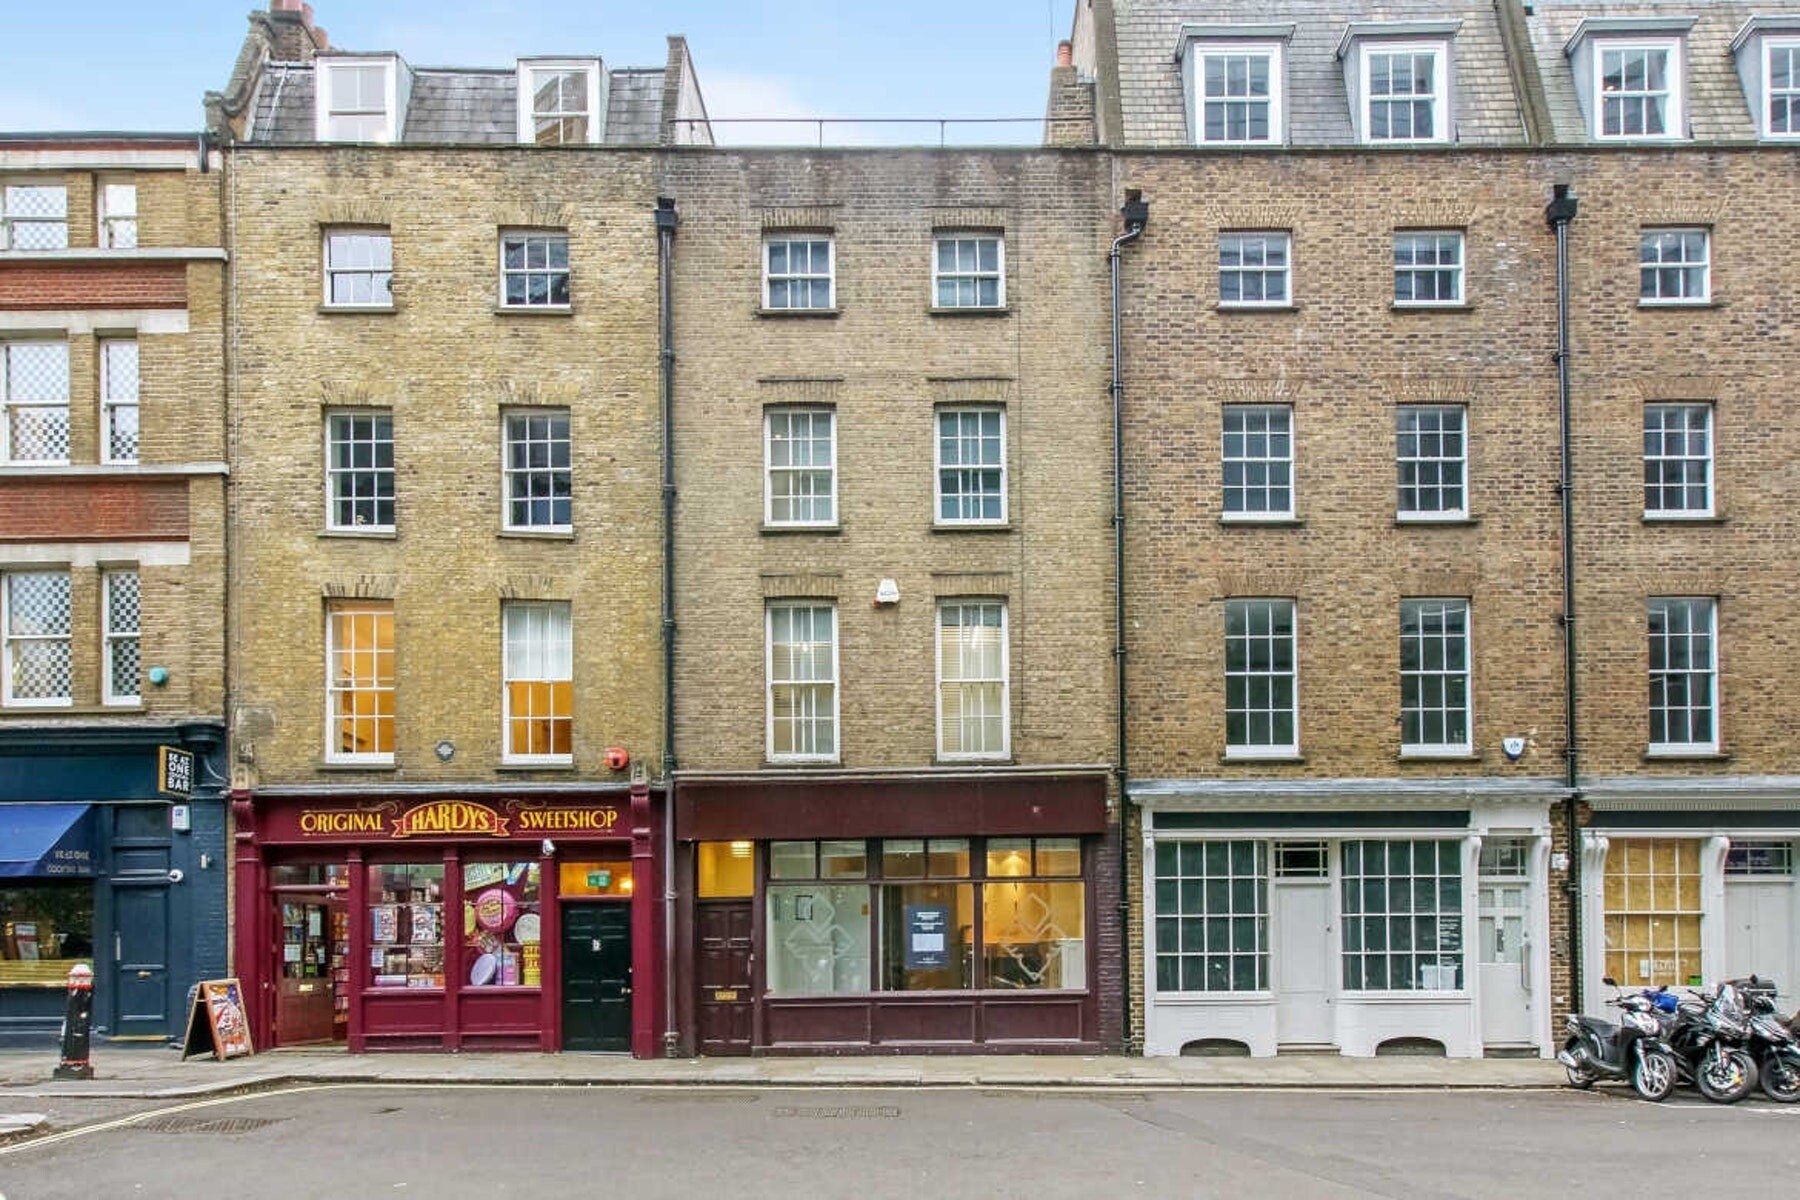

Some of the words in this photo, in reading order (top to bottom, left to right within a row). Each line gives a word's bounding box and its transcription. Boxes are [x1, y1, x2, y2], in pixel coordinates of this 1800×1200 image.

[168, 761, 190, 776] ONE
[167, 777, 189, 792] BAR
[301, 813, 385, 833] ORIGINAL
[411, 803, 489, 833] HARDYS
[520, 810, 618, 829] SWEETSHOP
